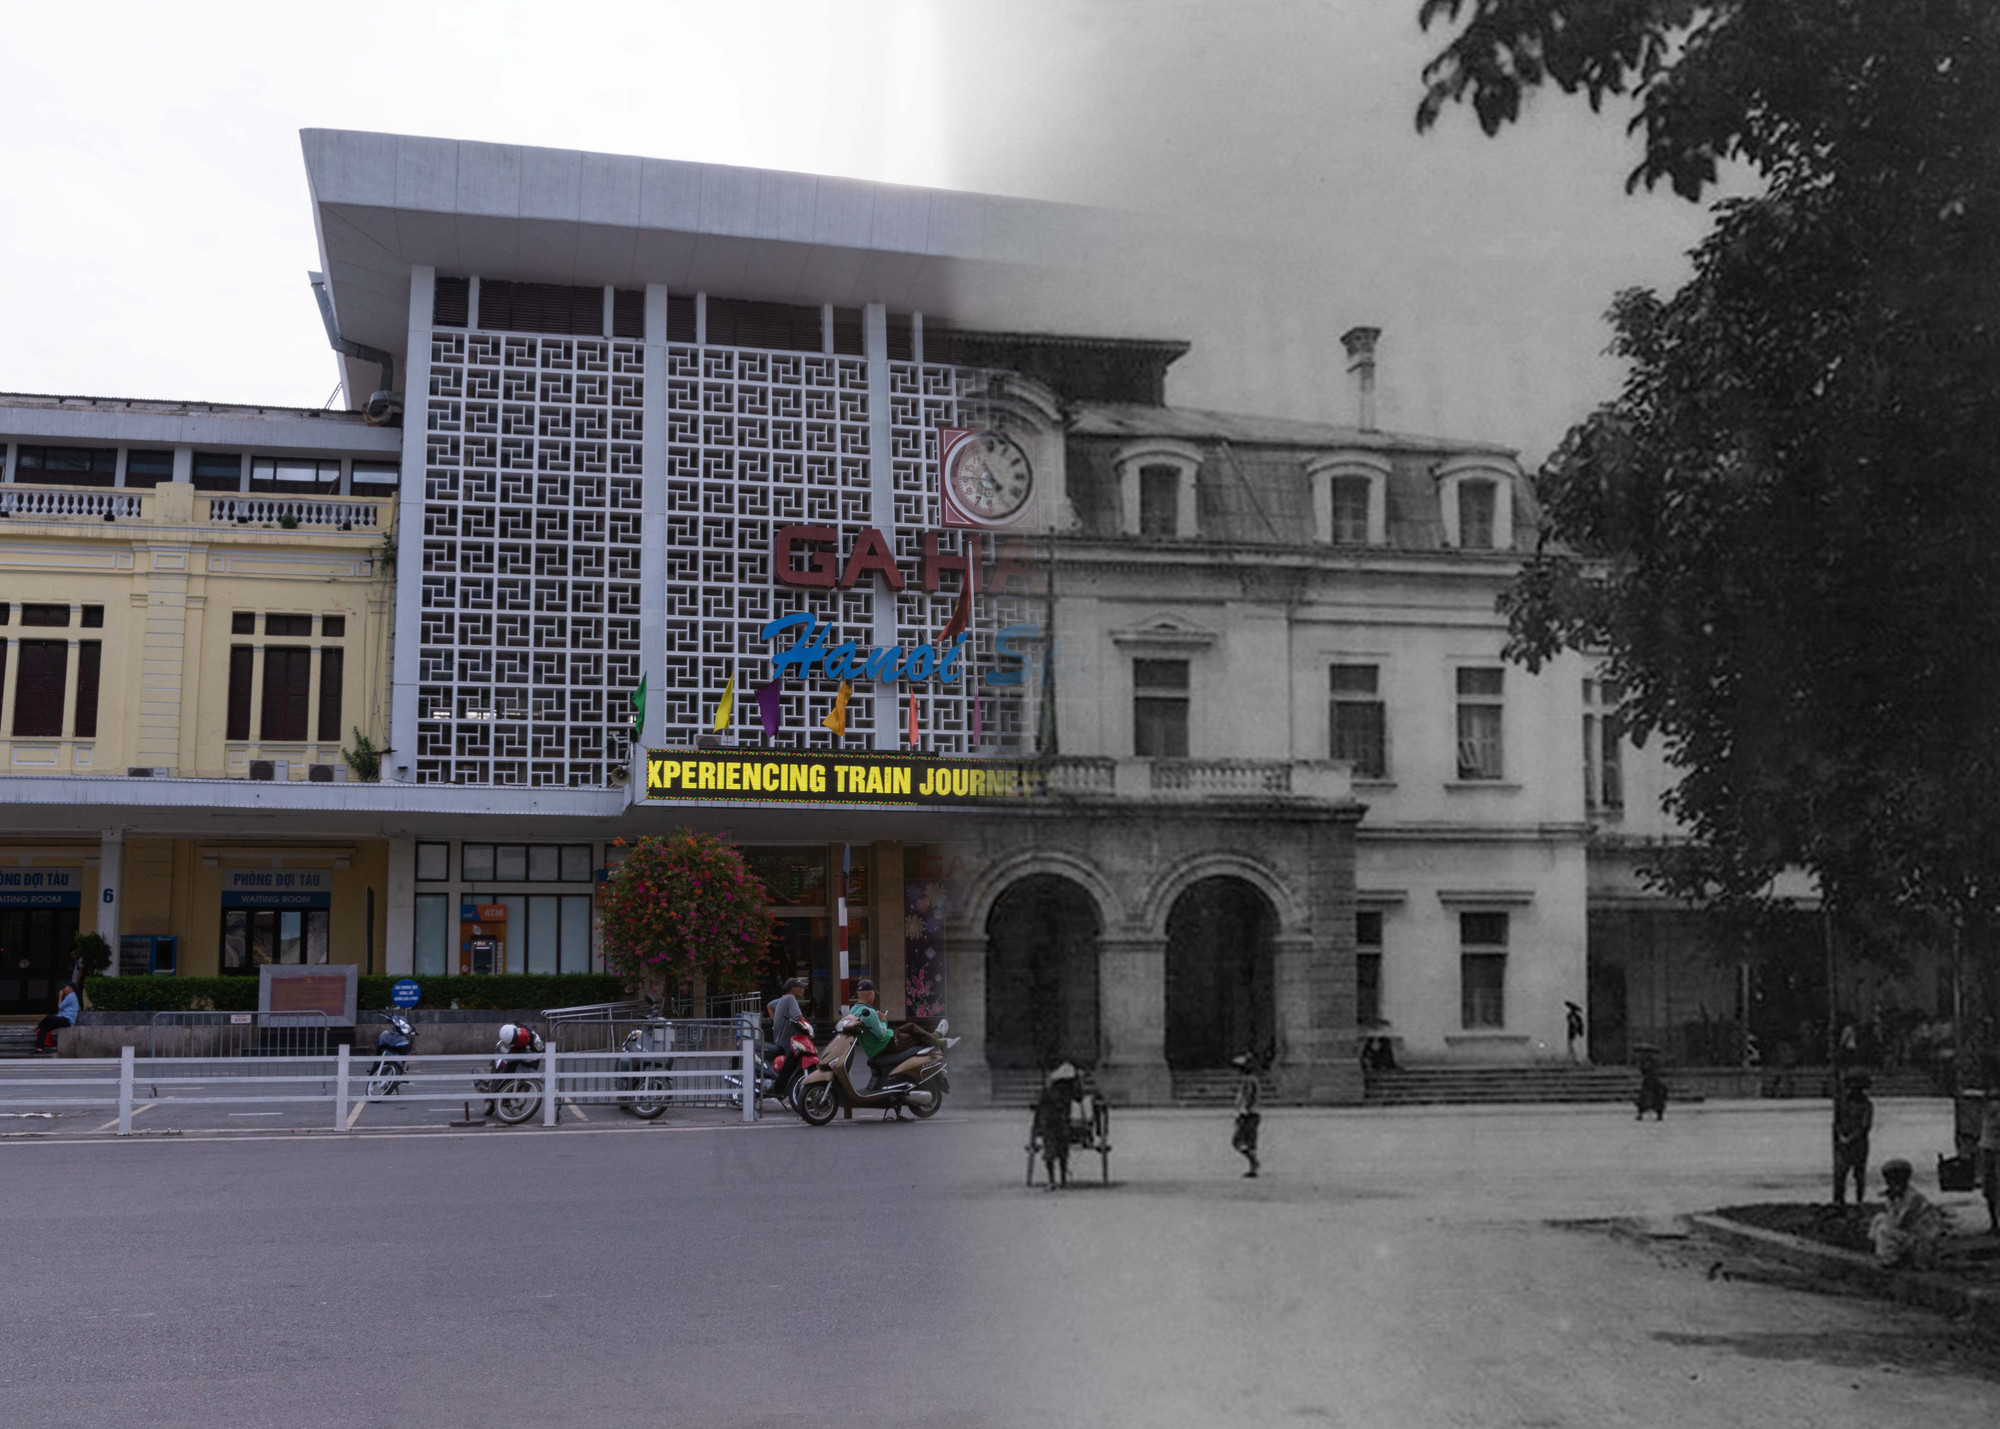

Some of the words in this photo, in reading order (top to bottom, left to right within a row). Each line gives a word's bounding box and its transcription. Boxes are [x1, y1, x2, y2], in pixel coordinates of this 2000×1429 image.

[776, 525, 906, 592] GA
[761, 611, 968, 684] Hanoi
[833, 765, 911, 794] TRAIN
[24, 872, 43, 888] ĐỢI
[47, 870, 69, 886] TÀU
[233, 870, 273, 887] PHÒNG
[275, 872, 295, 889] ĐỢI
[299, 871, 321, 887] TÀU
[30, 895, 62, 904] ROOM
[103, 888, 115, 904] 6
[241, 894, 281, 904] WAITING
[282, 894, 312, 904] ROOM
[484, 908, 504, 917] ATM
